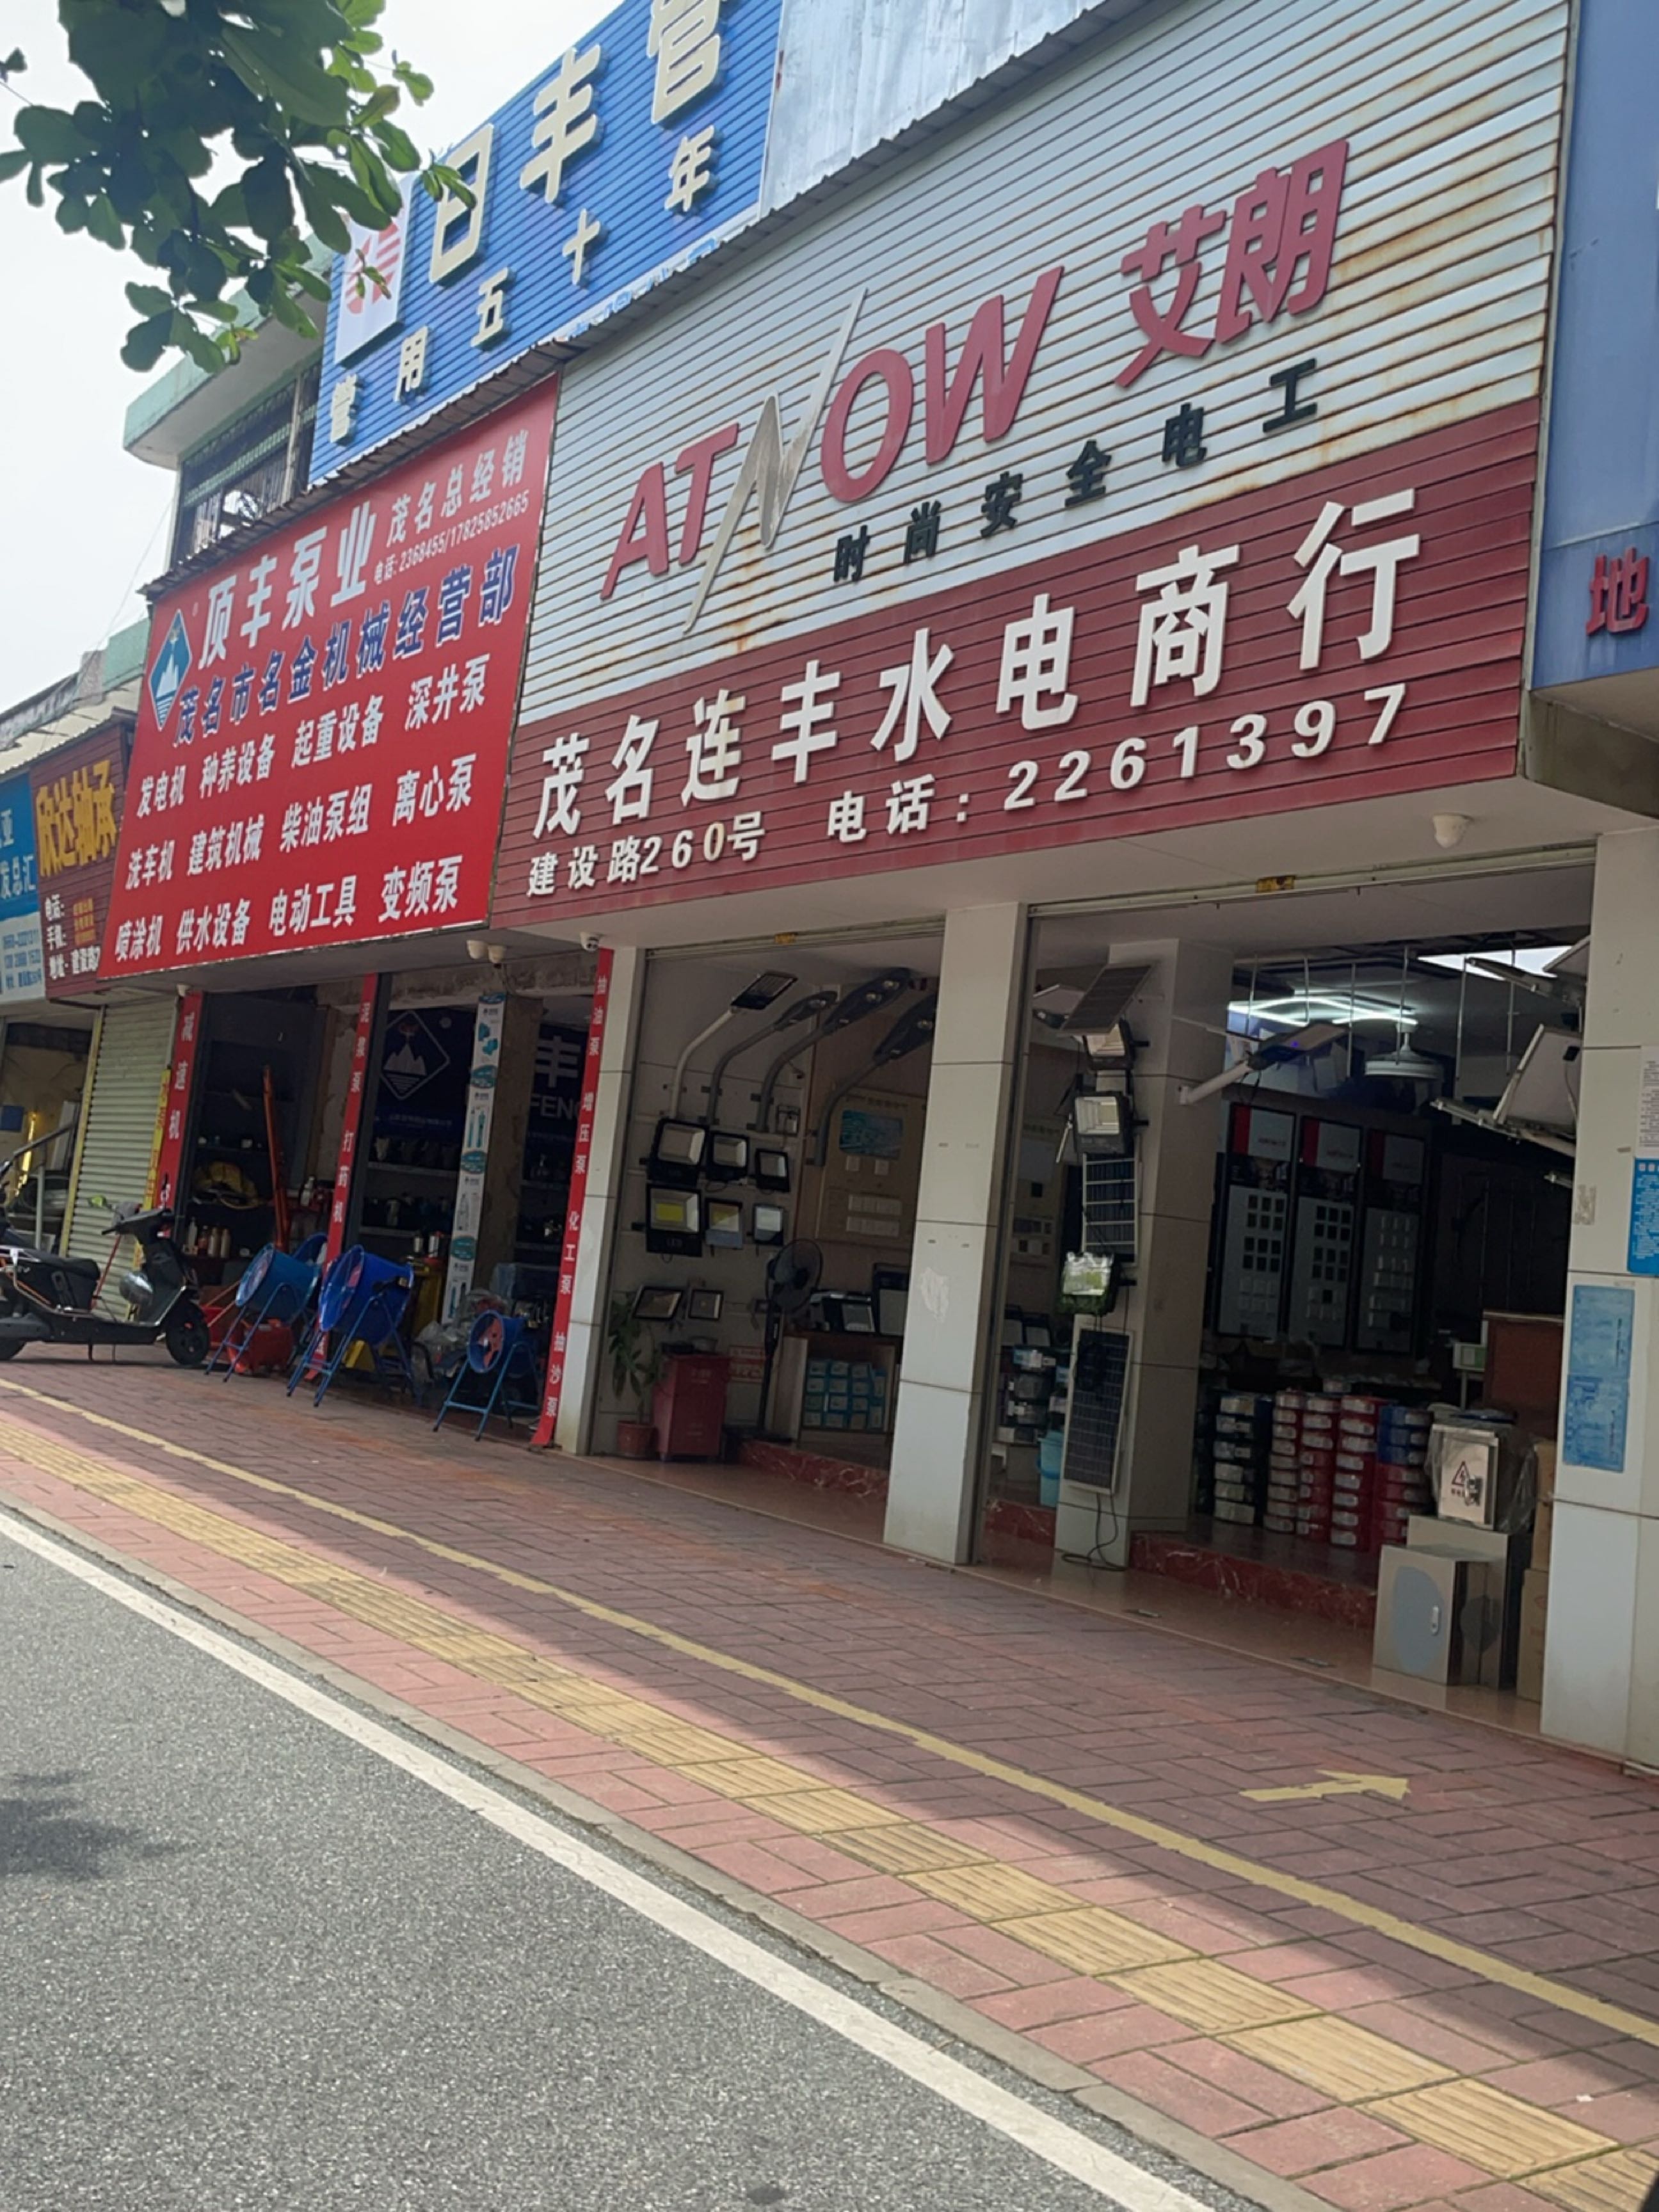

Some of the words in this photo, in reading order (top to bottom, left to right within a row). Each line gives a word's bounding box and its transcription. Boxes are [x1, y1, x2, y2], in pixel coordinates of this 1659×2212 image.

[600, 265, 1065, 636] ATNOW
[1115, 138, 1349, 387] 艾朗
[386, 429, 529, 548] 茂名总经销
[833, 357, 1318, 583] 时尚安全电工
[173, 543, 520, 748] 茂名市名金机械经营部
[198, 501, 378, 671] 顶丰泵业
[1585, 547, 1649, 636] 地
[136, 765, 186, 819] 发电机
[199, 733, 276, 799] 种养设备
[291, 695, 384, 769] 起重设备
[405, 653, 491, 732] 深井泵
[532, 488, 1421, 839] 茂名连丰水电商行
[126, 840, 175, 890] 洗车机
[187, 813, 265, 876] 建筑机械
[280, 783, 373, 853] 柴油泵组
[392, 754, 477, 827] 离心泵
[527, 811, 765, 899] 建设路260号
[115, 914, 164, 963] 喷涂机
[176, 899, 251, 956] 供水设备
[269, 875, 357, 937] 电动工具
[378, 854, 463, 923] 变频泵
[531, 1094, 580, 1121] FEN
